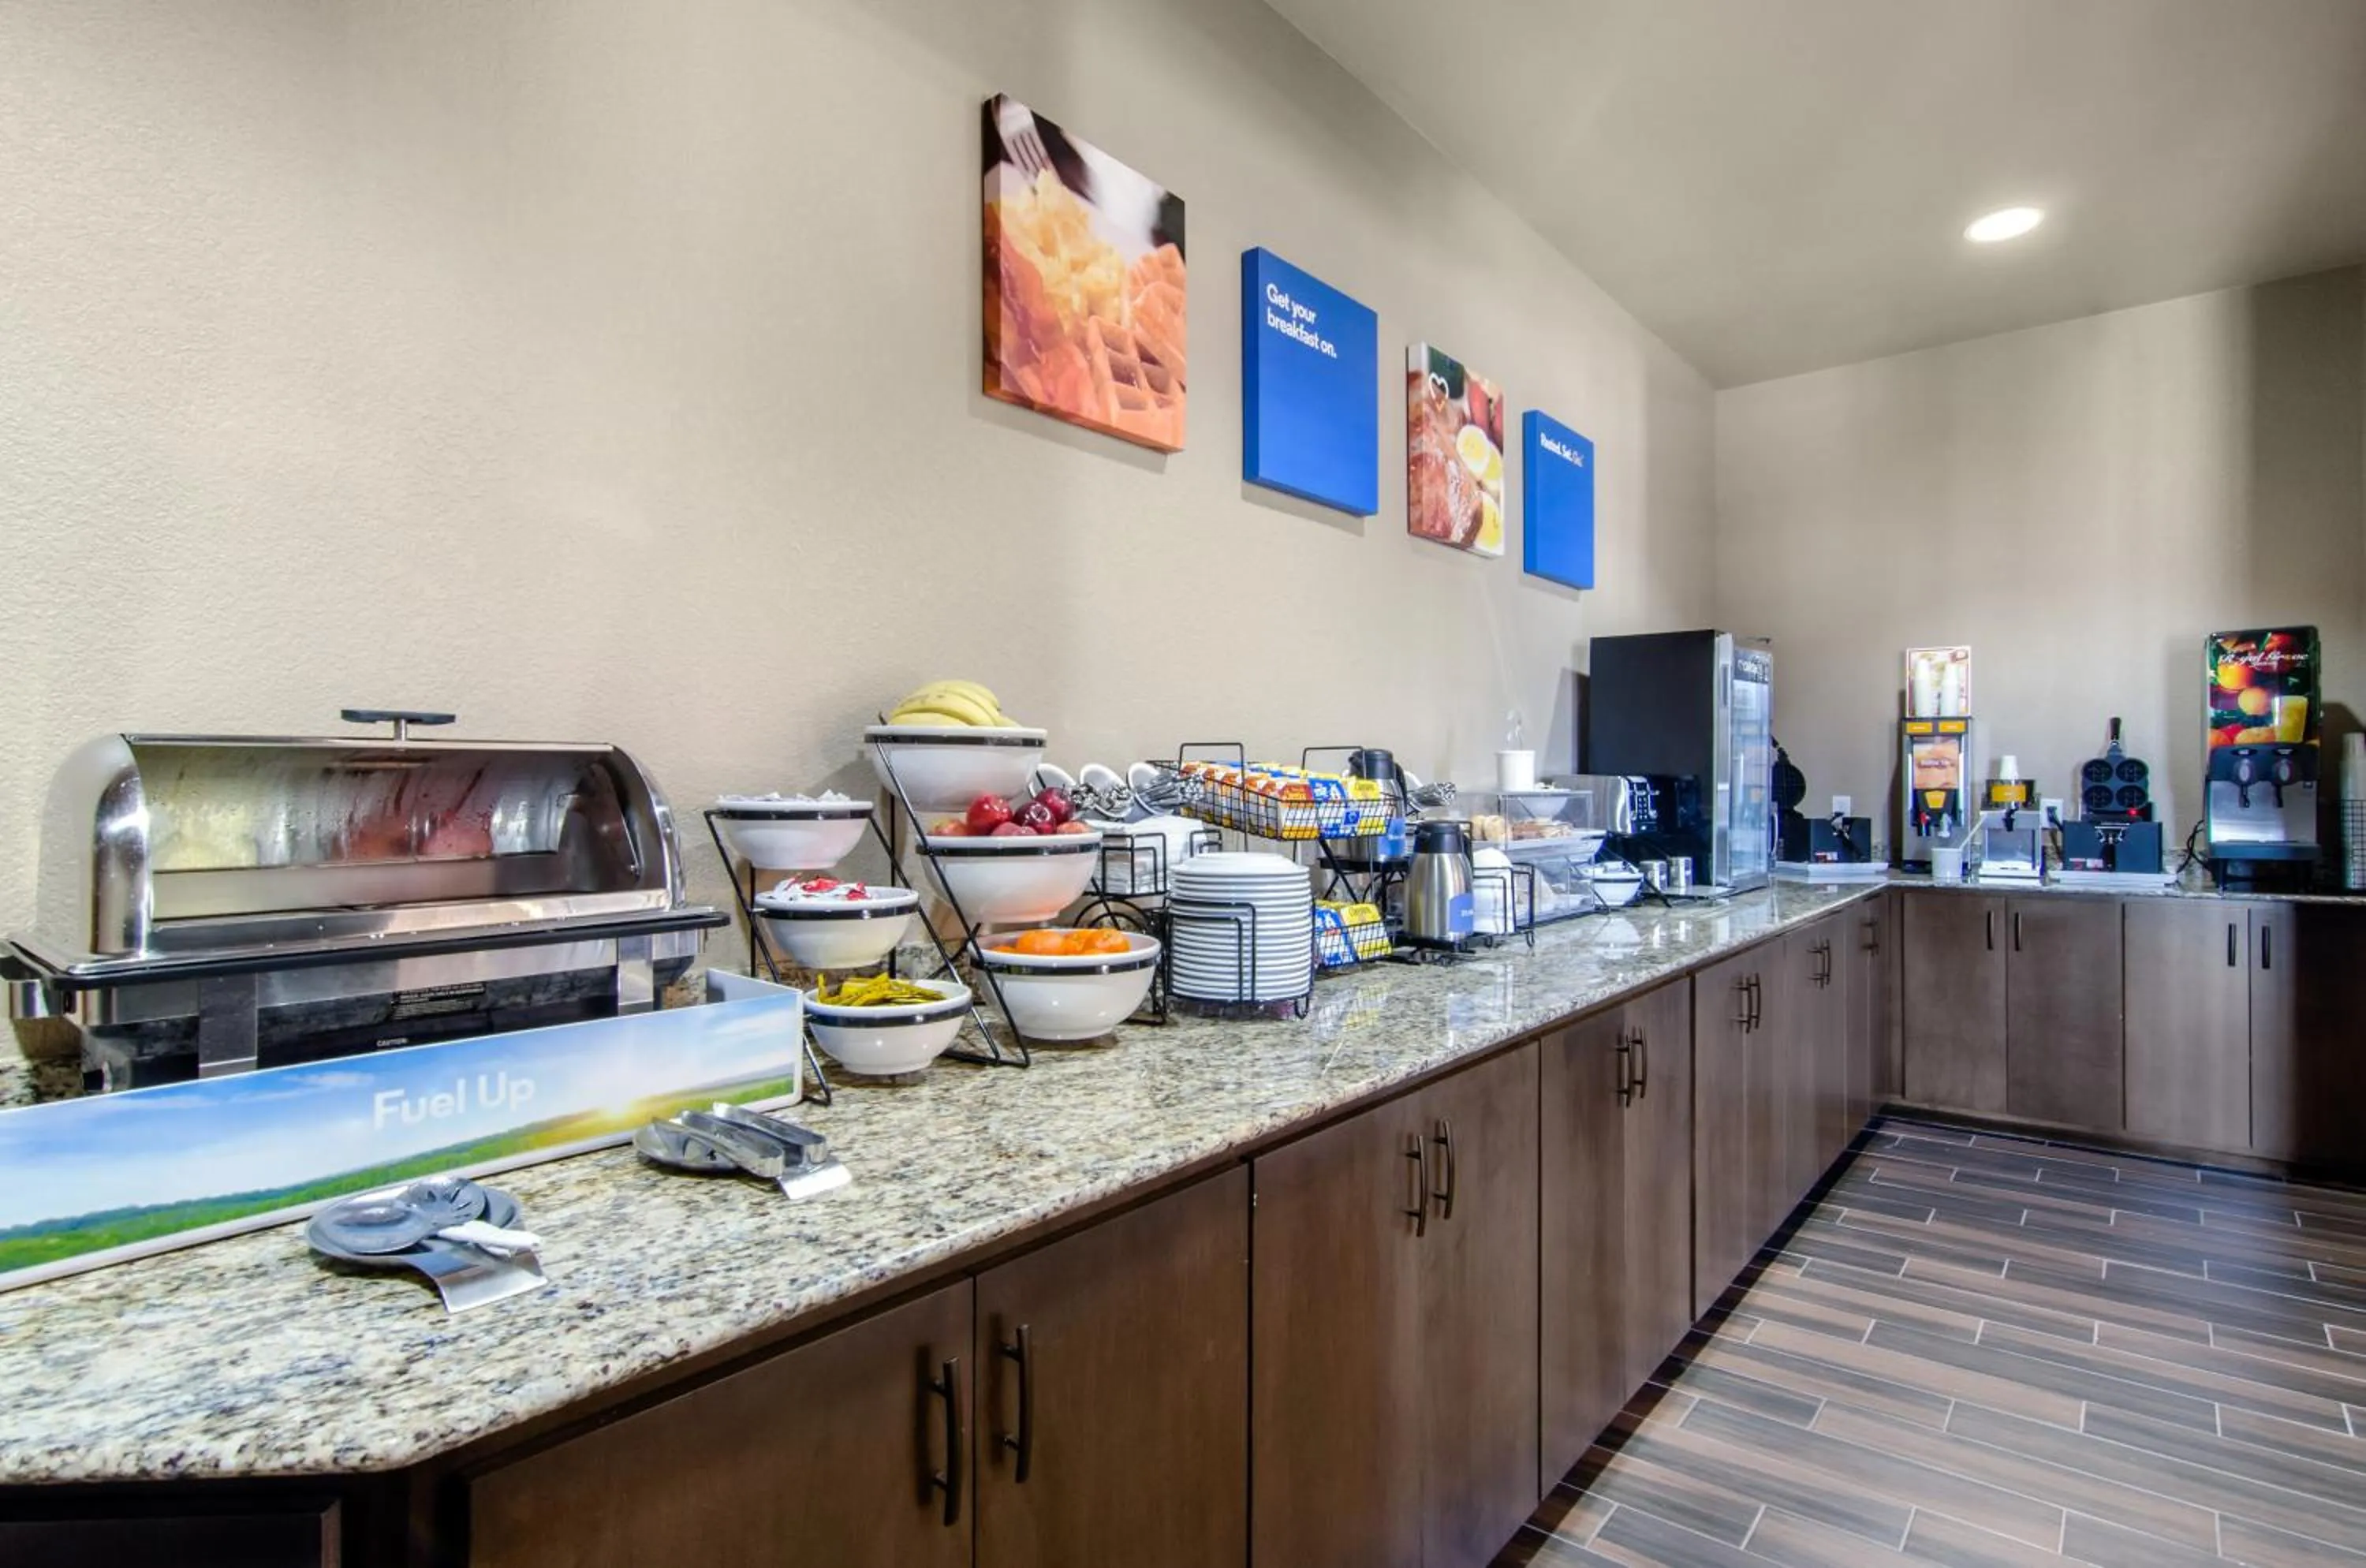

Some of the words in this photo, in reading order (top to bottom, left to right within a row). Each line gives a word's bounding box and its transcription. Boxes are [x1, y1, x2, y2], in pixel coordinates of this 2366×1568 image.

[1267, 282, 1289, 312] Get
[1292, 301, 1316, 325] your
[1267, 306, 1319, 349] breakfast
[1320, 340, 1338, 359] on.
[374, 1077, 466, 1131] Fuel
[478, 1072, 535, 1111] Up
